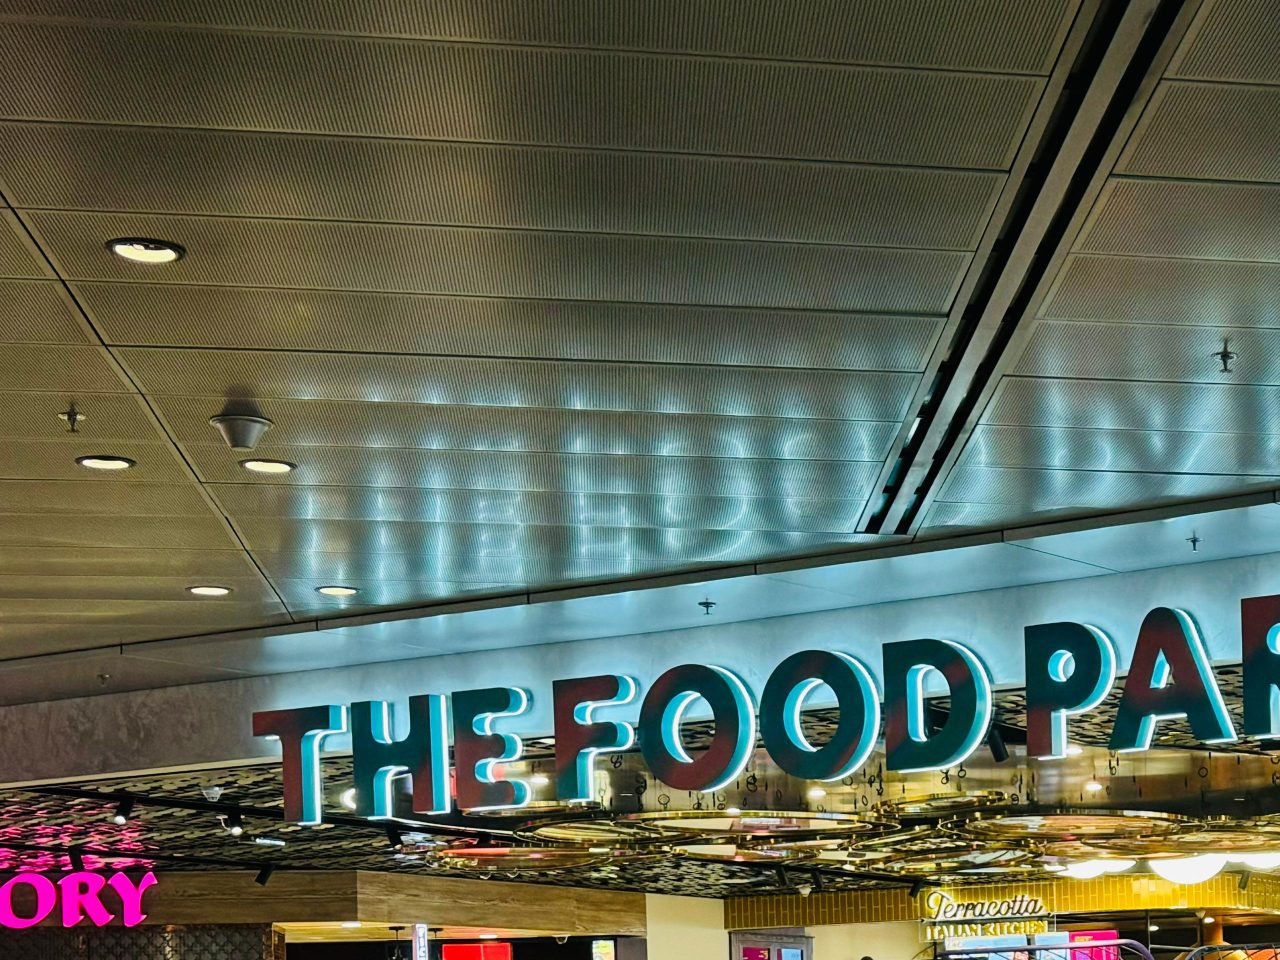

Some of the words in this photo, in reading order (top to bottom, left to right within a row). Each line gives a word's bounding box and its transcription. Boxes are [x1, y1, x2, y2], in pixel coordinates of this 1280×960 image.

[253, 684, 530, 826] THE
[552, 637, 993, 803] FOOD
[926, 891, 1045, 920] Terracotta
[926, 923, 981, 940] ITALIAN
[983, 920, 1048, 936] KITCHEN
